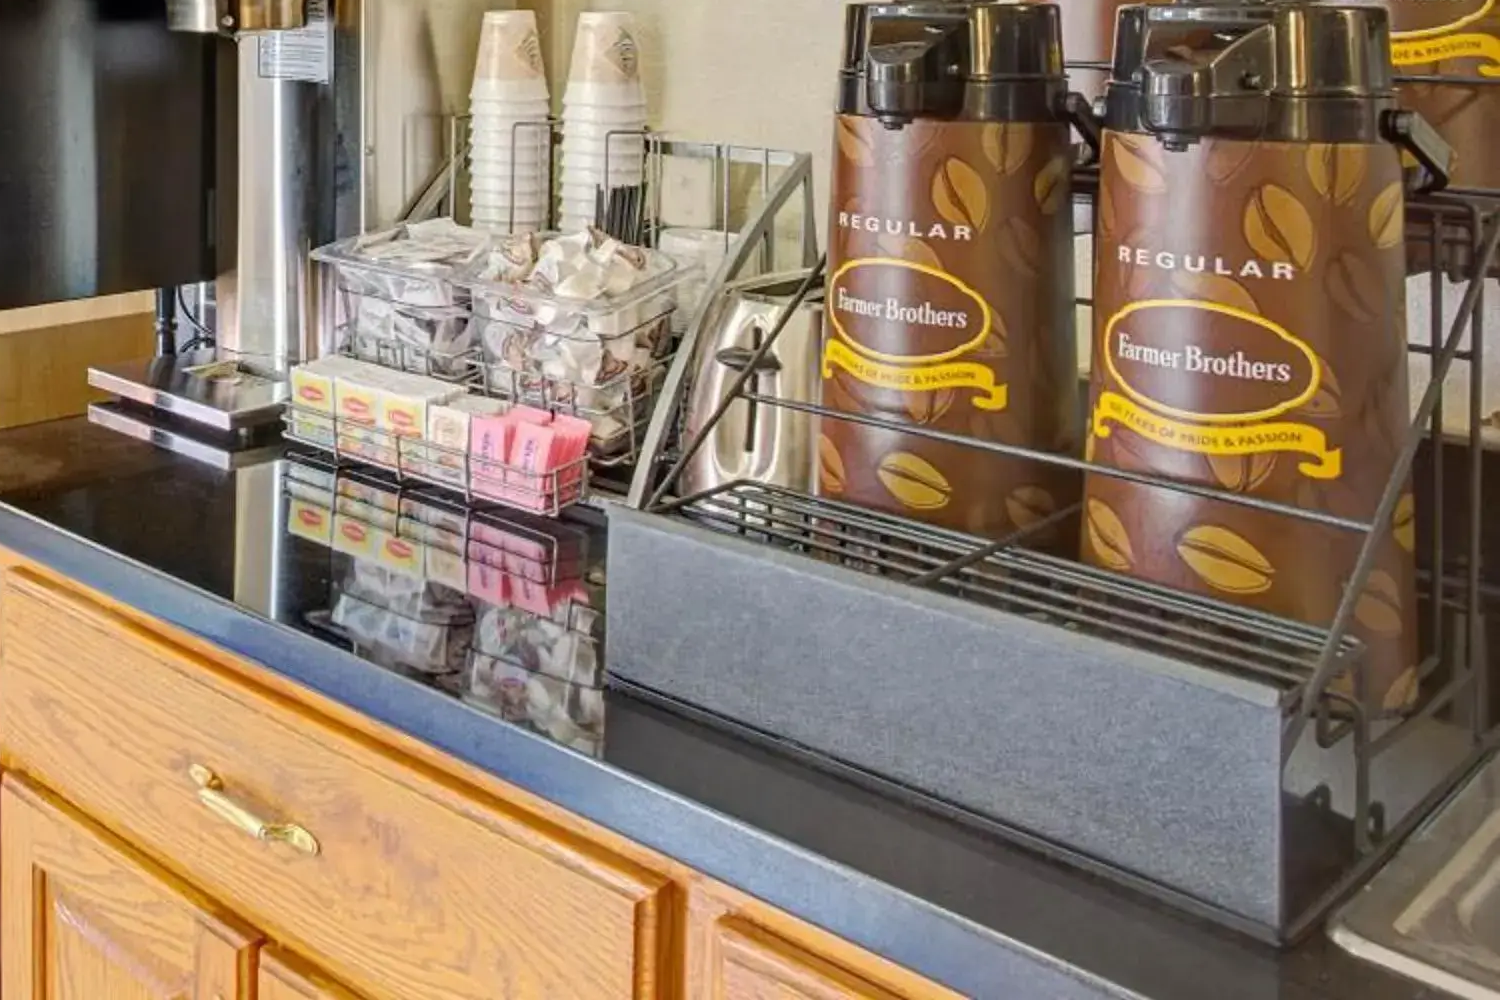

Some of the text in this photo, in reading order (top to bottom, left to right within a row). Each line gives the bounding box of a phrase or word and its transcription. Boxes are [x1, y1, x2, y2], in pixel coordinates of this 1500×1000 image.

[839, 211, 973, 241] REGULAR
[1118, 245, 1295, 281] REGULAR
[838, 287, 968, 329] Farmer Brothers
[1118, 331, 1292, 383] Farmer Brothers
[1181, 433, 1219, 448] PRIDE
[1238, 431, 1302, 447] PASSION
